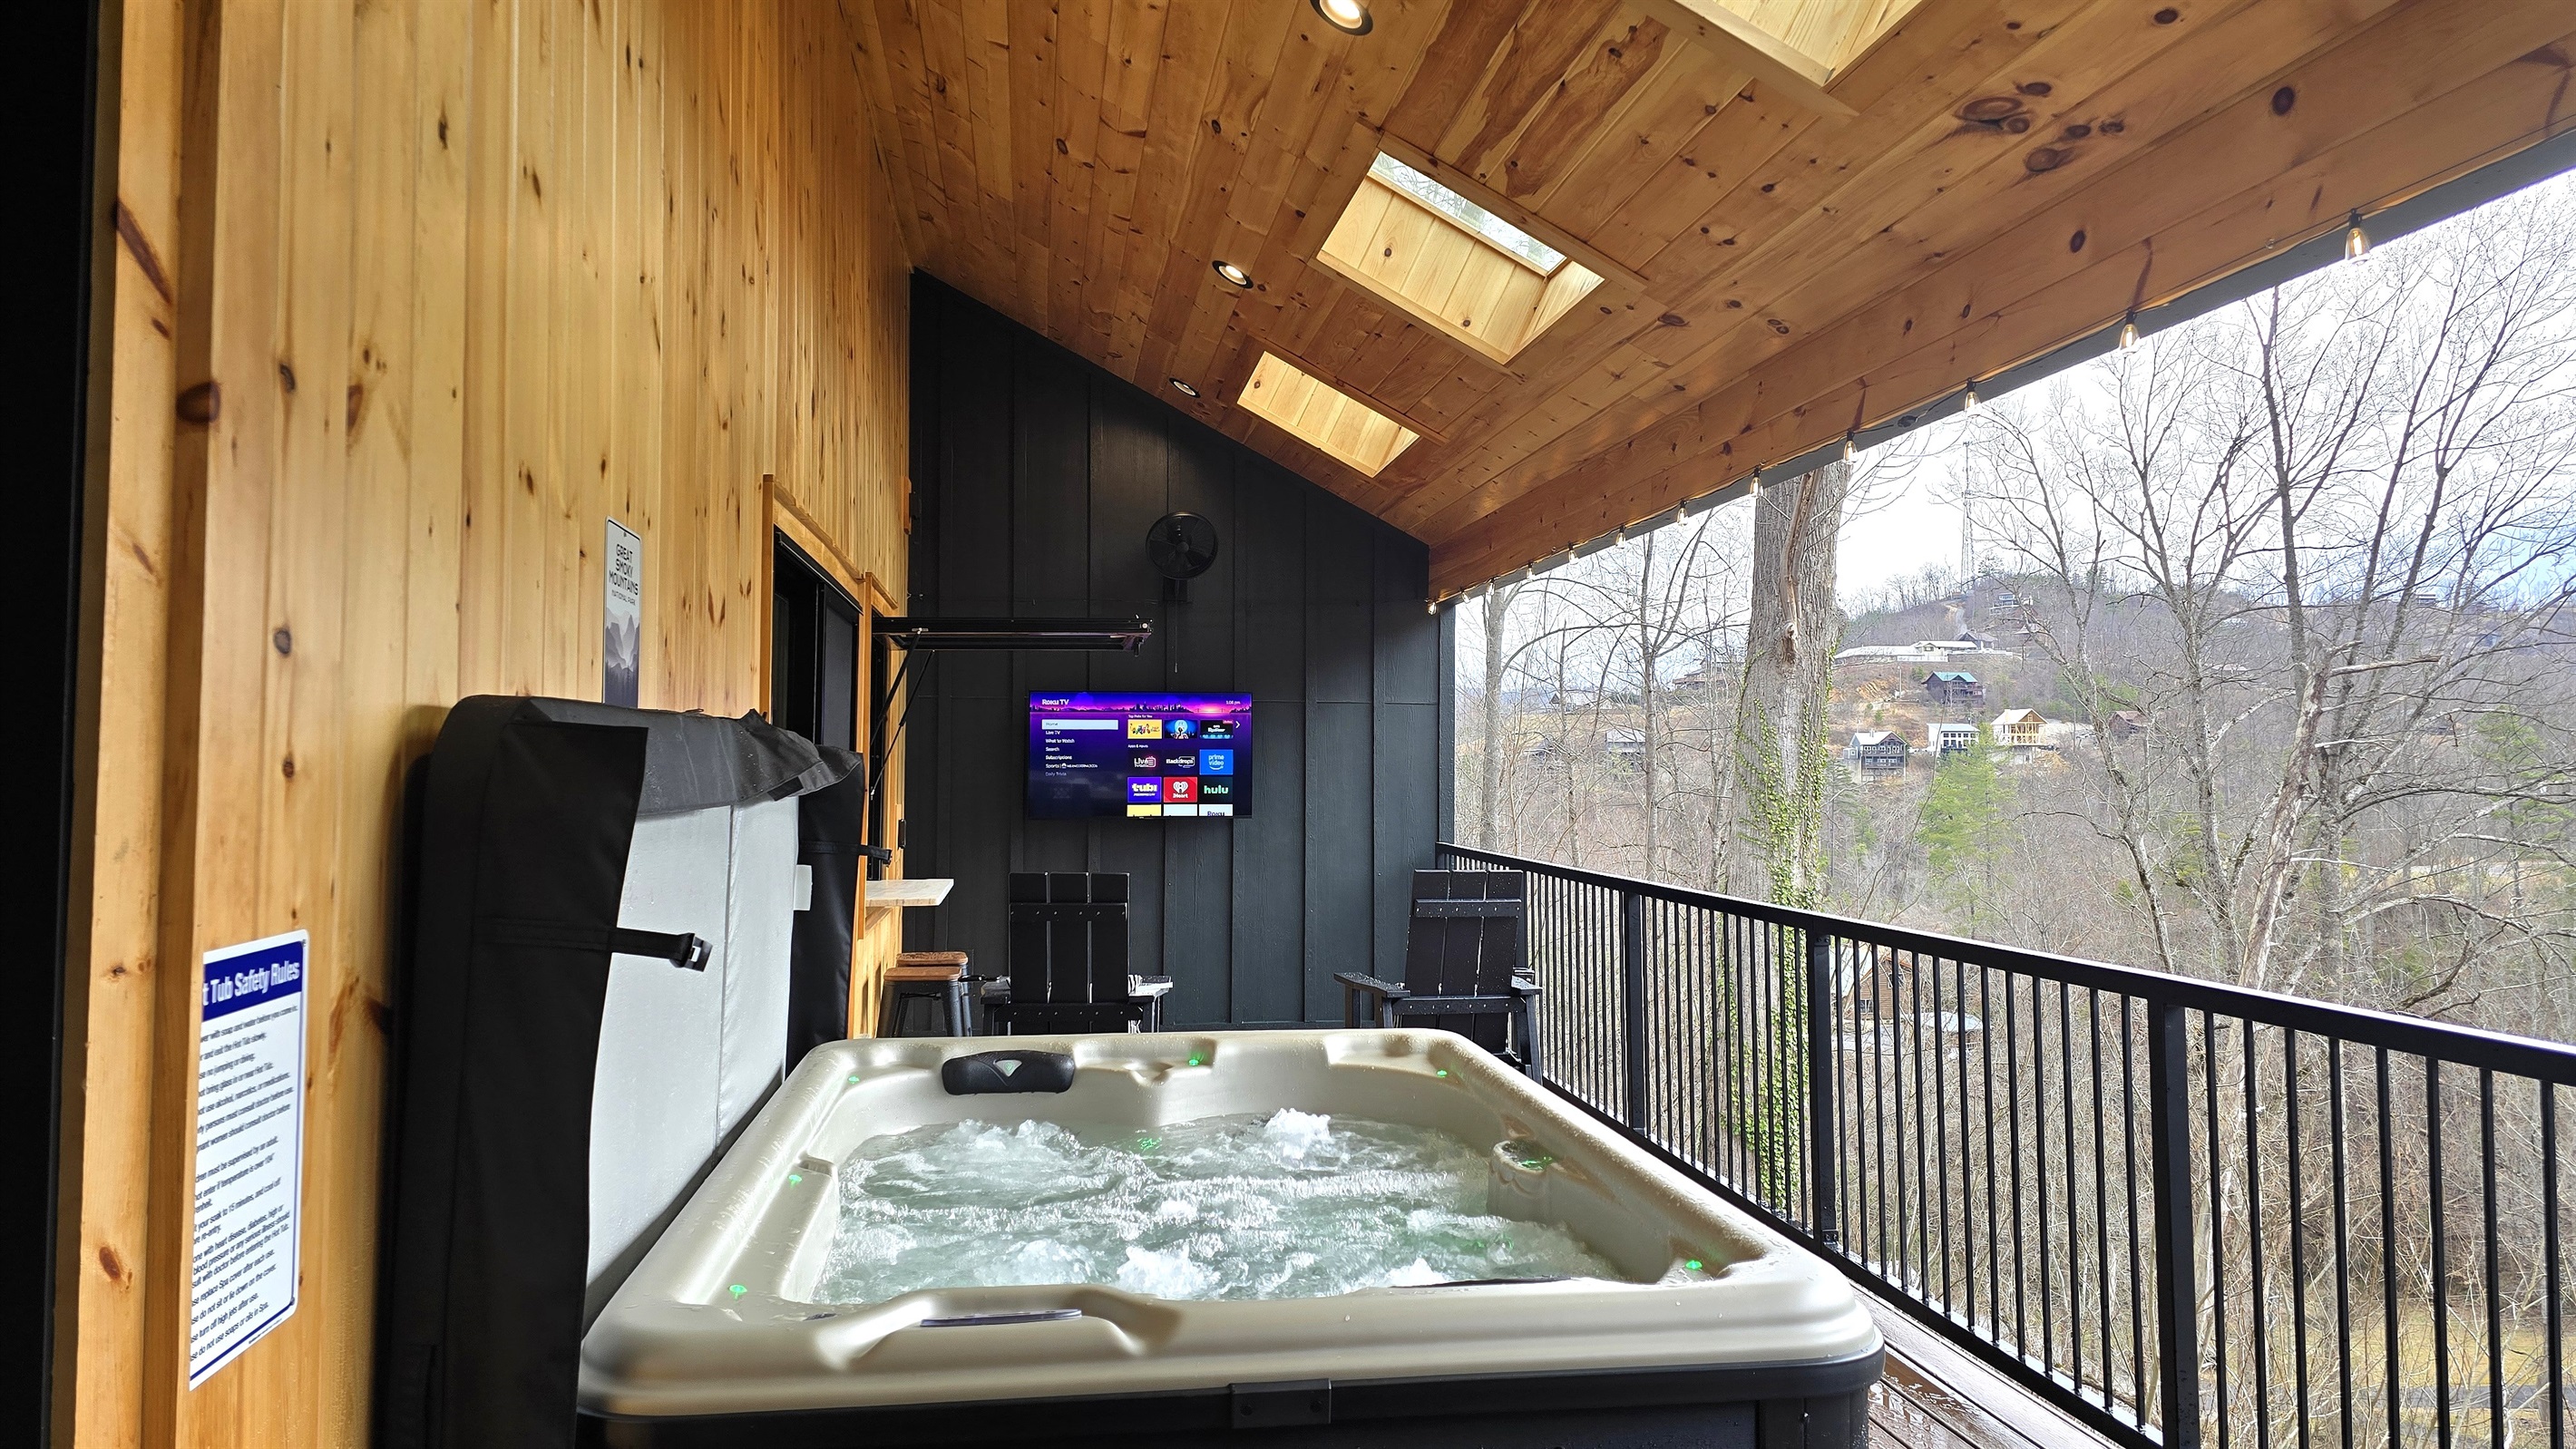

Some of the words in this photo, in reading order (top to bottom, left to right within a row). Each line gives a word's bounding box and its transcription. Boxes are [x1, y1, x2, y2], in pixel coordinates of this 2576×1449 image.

[617, 544, 632, 563] GREAT
[616, 559, 633, 578] SMOKY
[609, 570, 638, 595] MOUNTAINS
[612, 589, 627, 602] NATIONAL
[1132, 783, 1157, 792] tubi
[1204, 785, 1228, 793] hulu
[210, 977, 233, 1003] Tub
[235, 968, 269, 996] Safety
[271, 961, 299, 986] Rules
